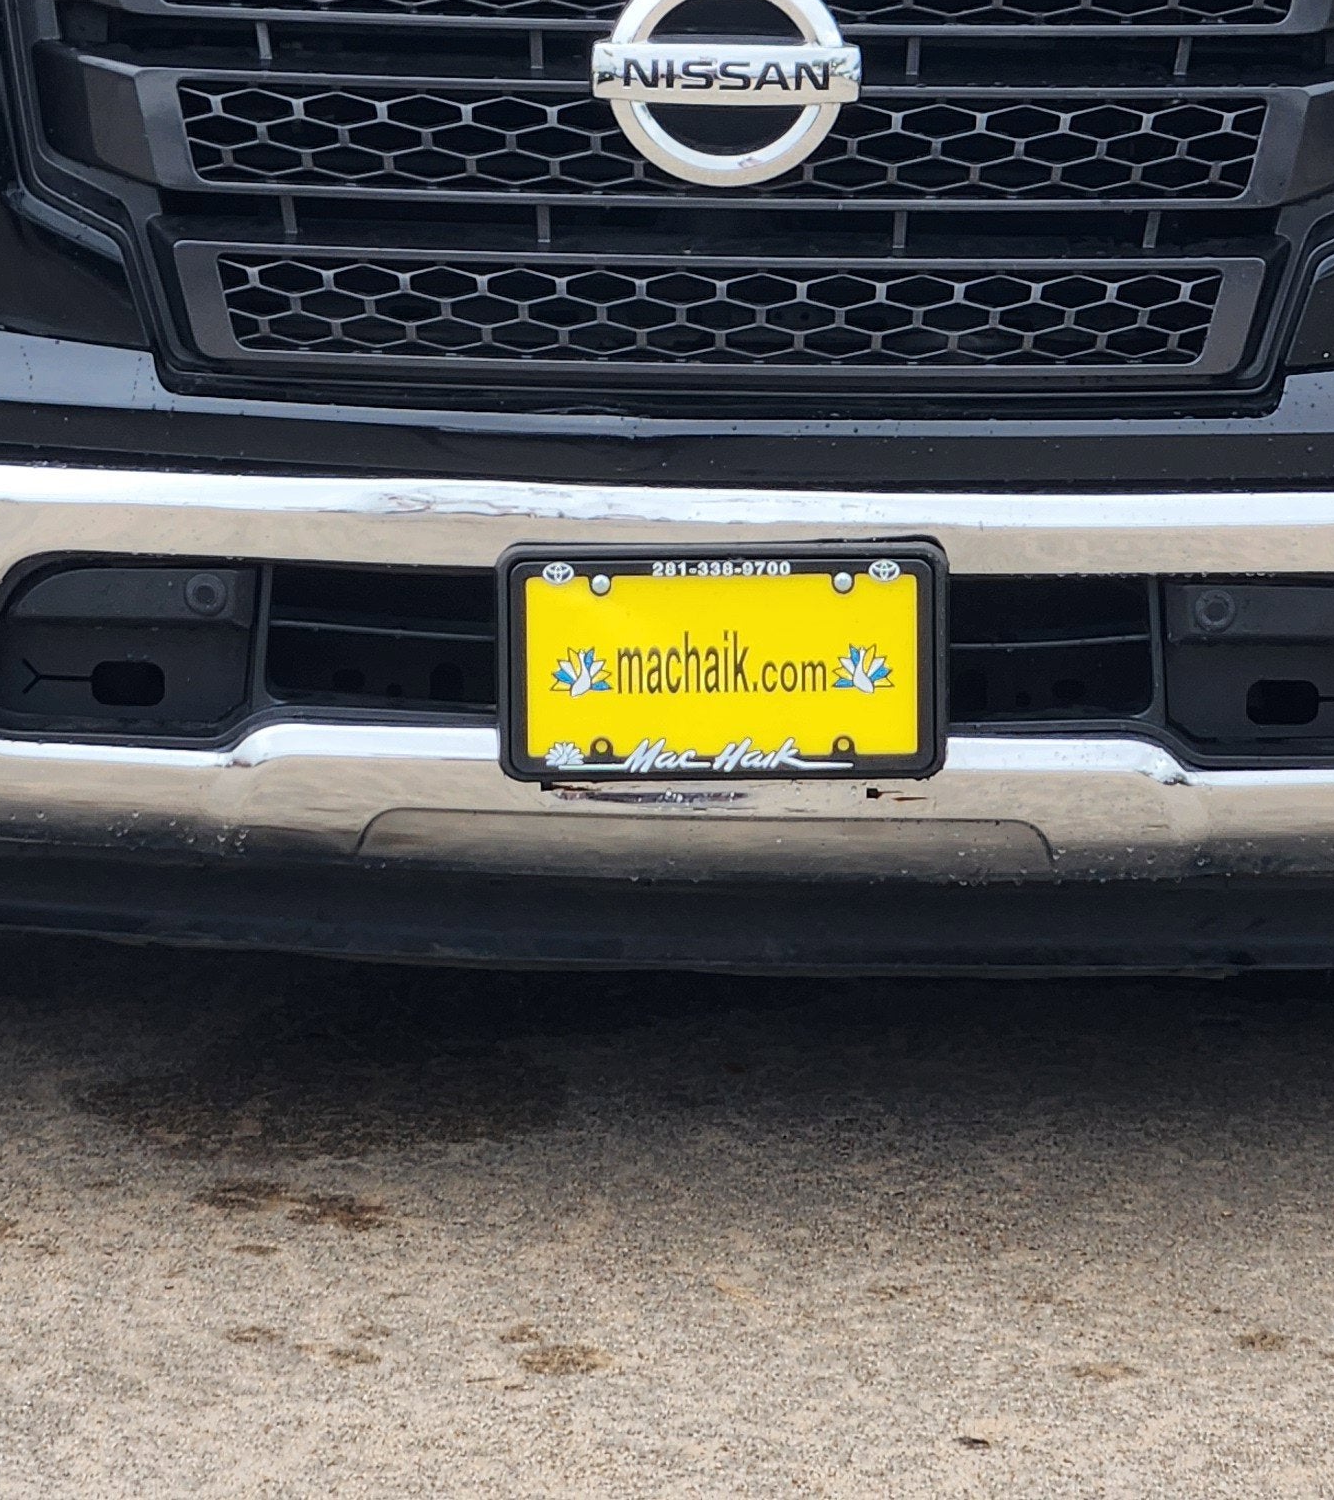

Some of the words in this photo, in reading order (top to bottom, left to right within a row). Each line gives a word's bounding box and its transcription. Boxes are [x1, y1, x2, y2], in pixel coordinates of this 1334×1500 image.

[622, 58, 830, 91] NISSAN
[651, 561, 792, 577] 281-338-9700
[617, 630, 828, 694] machaik.com
[624, 738, 710, 773] Mac
[712, 737, 809, 773] Haik
